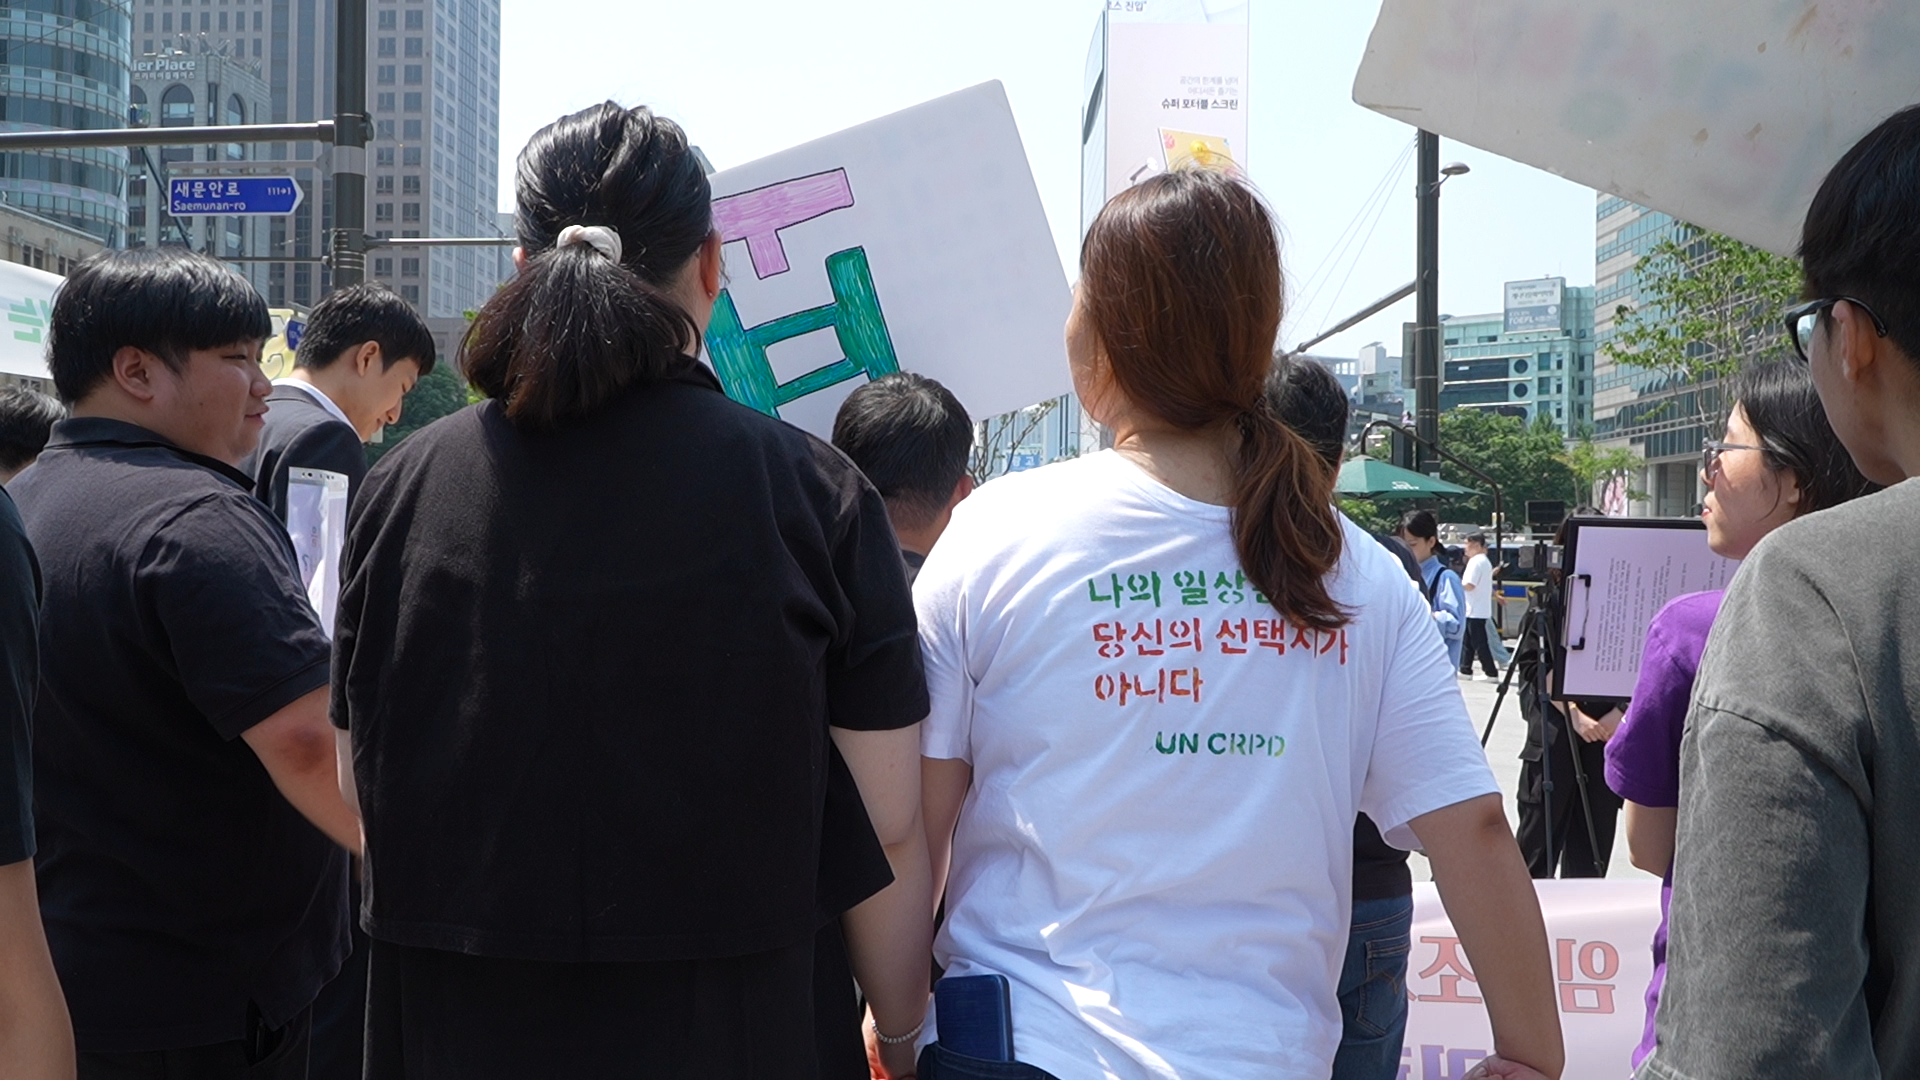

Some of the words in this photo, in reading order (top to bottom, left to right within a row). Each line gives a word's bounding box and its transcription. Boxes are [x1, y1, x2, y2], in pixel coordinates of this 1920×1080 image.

[155, 59, 196, 71] Place
[1161, 98, 1180, 110] 슈퍼
[1211, 98, 1238, 110] 스크린
[174, 181, 240, 198] 새문안로
[173, 200, 246, 211] Saemunan-ro
[1088, 571, 1161, 608] 나의
[1093, 618, 1202, 657] 당신의
[1216, 617, 1348, 665] 선택지가
[1094, 667, 1203, 706] 아니다
[1155, 732, 1199, 754] UN
[1207, 732, 1286, 757] CRPD
